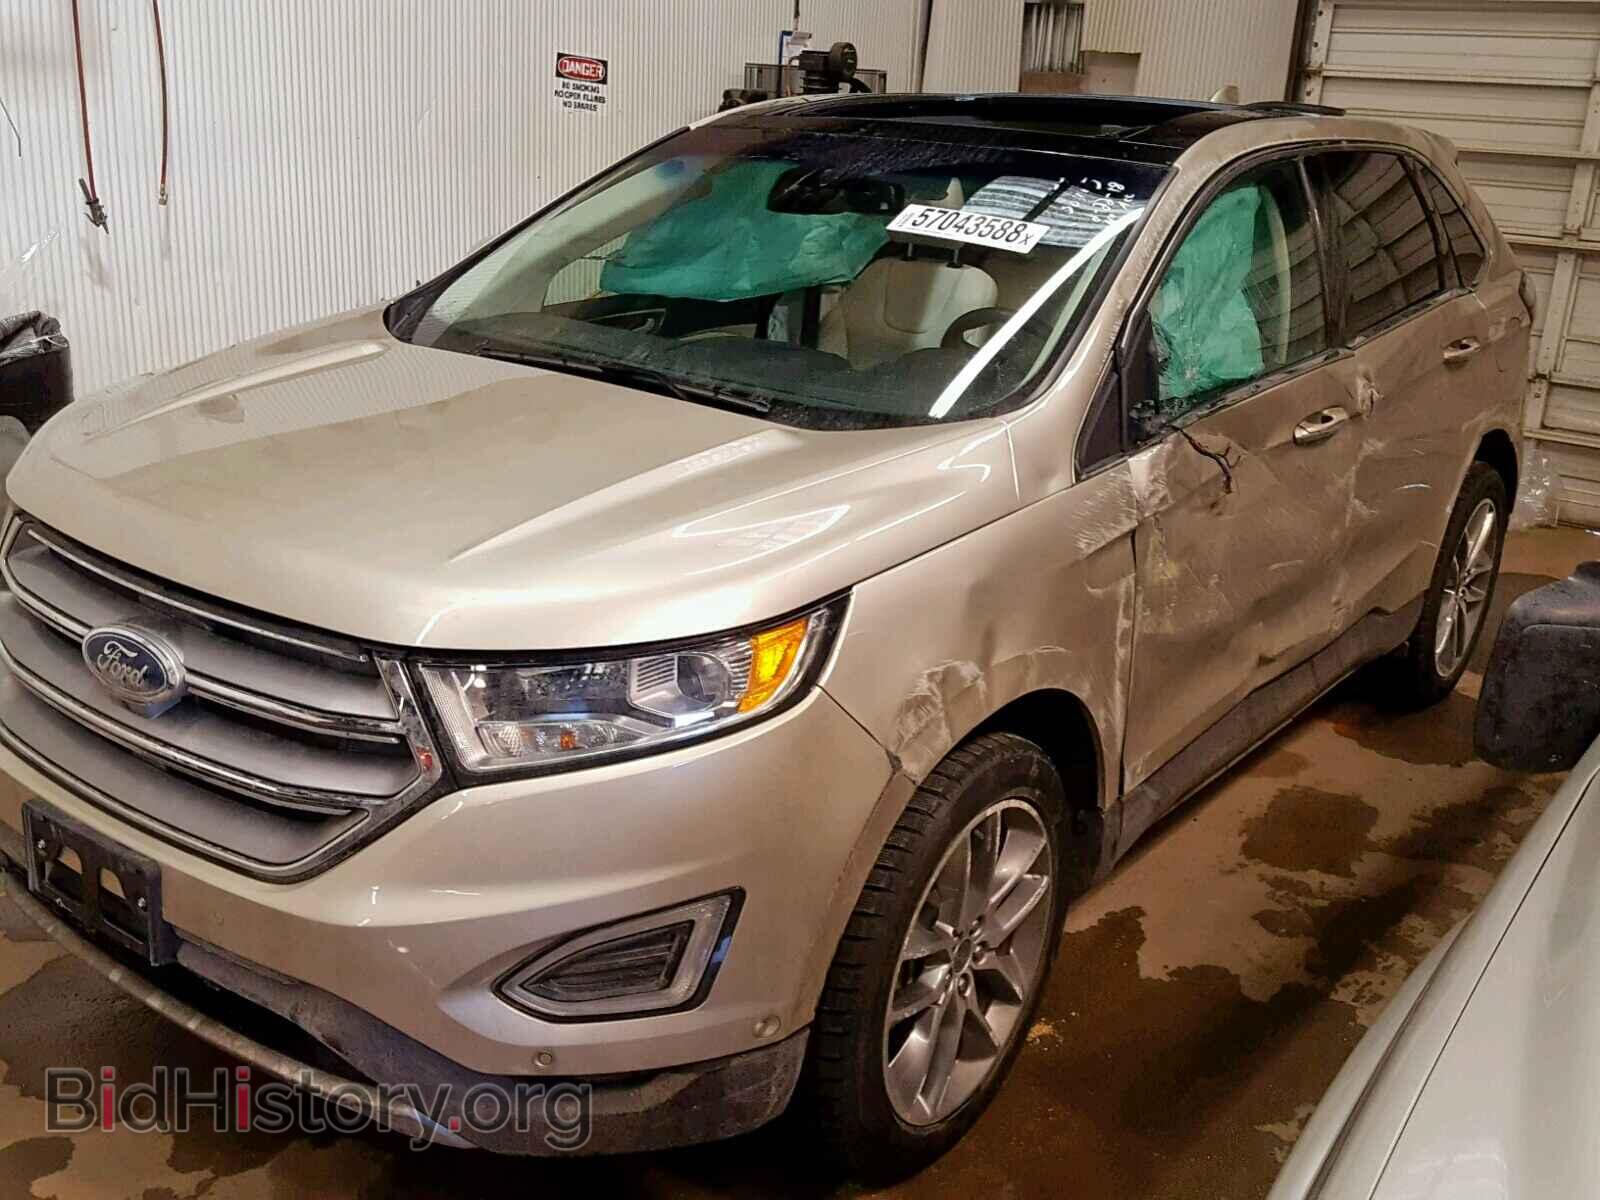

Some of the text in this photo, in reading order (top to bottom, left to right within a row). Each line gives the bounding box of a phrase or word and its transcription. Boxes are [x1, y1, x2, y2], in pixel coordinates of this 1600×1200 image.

[560, 60, 603, 77] DANGER
[555, 90, 564, 98] NO
[911, 208, 1028, 243] 57043588
[97, 641, 148, 687] Ford
